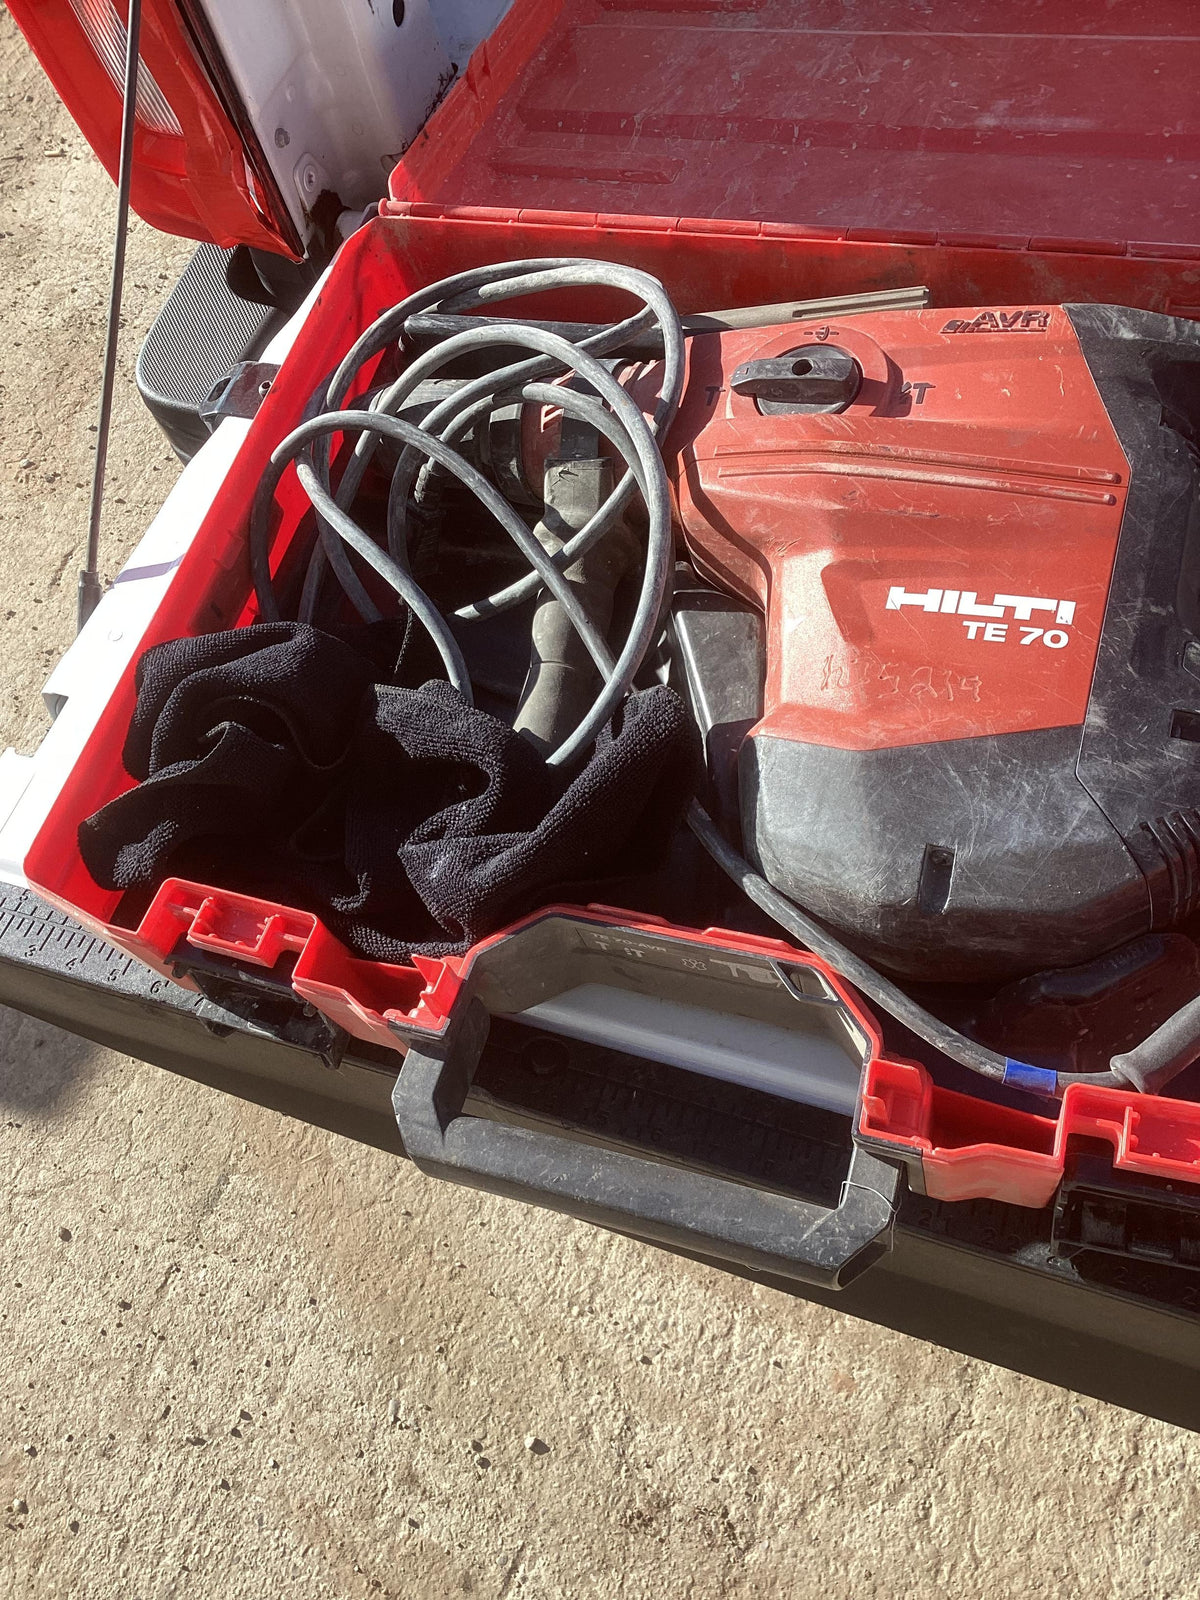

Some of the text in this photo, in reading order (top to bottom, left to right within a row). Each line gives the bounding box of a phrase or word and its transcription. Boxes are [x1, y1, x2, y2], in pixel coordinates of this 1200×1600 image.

[971, 310, 1050, 328] AVR
[885, 586, 1076, 625] HILTI
[962, 620, 1068, 648] TE 70
[24, 944, 37, 958] 3
[65, 957, 78, 971] 4
[107, 968, 120, 982] 5
[149, 980, 162, 995] 6
